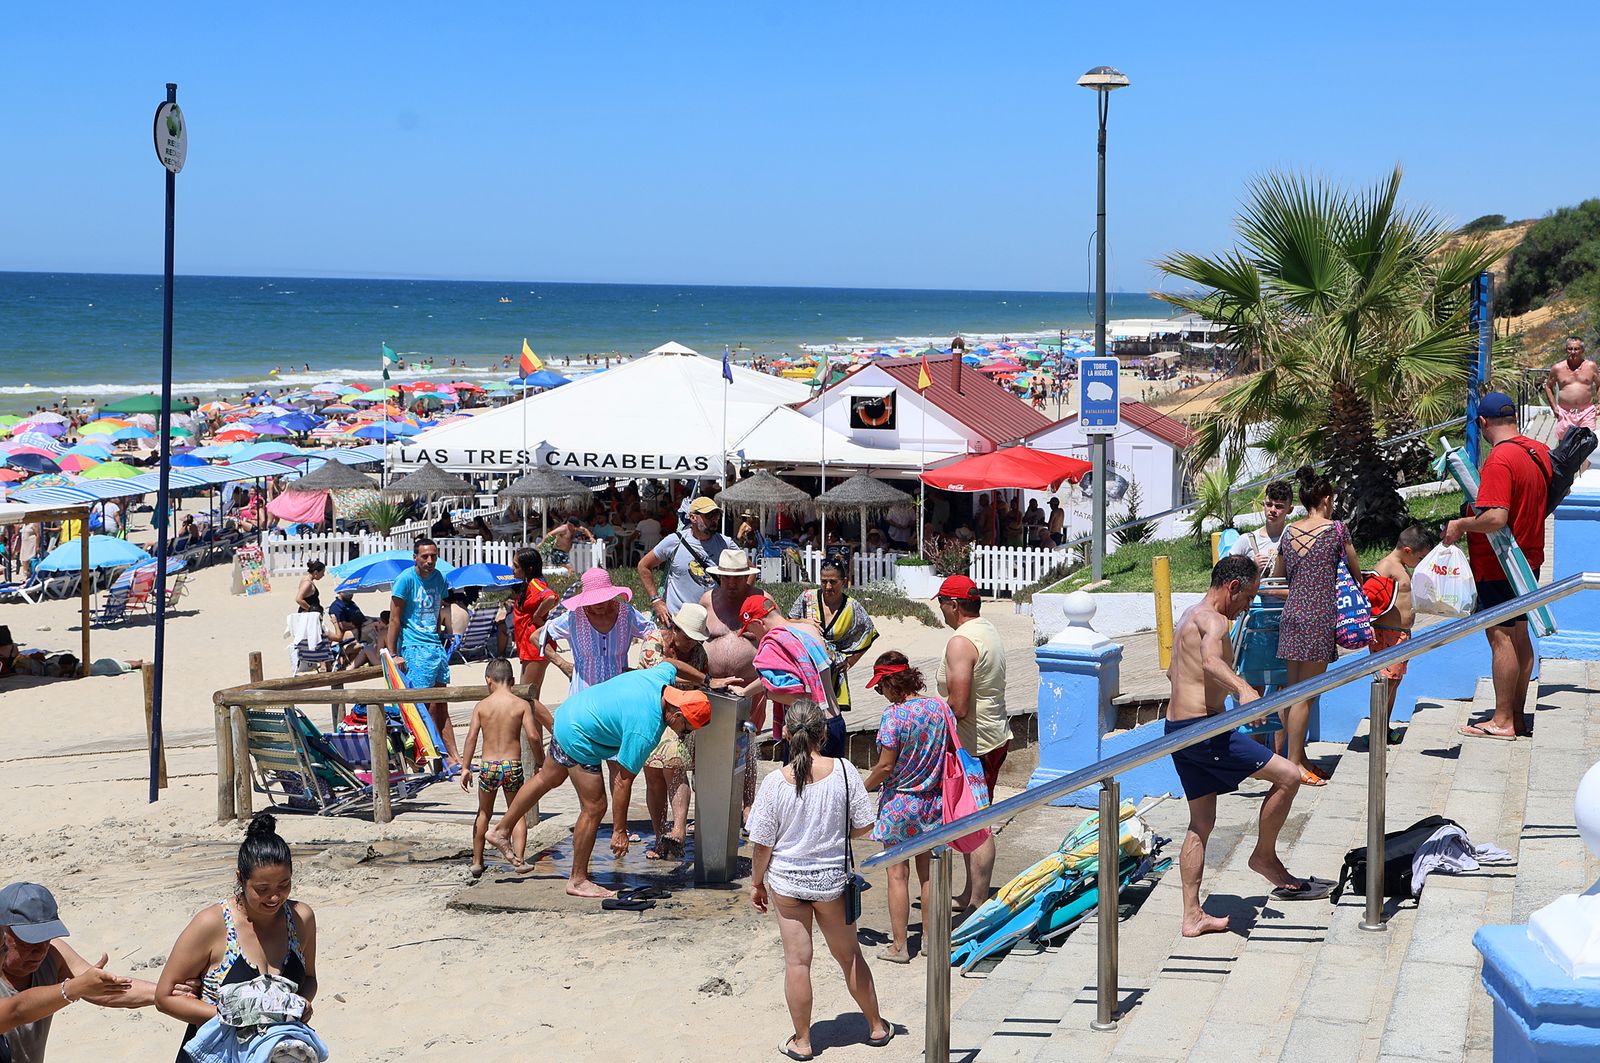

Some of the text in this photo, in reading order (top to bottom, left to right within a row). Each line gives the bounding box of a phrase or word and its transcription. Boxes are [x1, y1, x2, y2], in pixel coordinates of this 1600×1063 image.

[1094, 369, 1114, 377] HIGUERA
[400, 448, 710, 471] LAS TRES CARABELAS
[1071, 453, 1131, 473] TRES ABELAS
